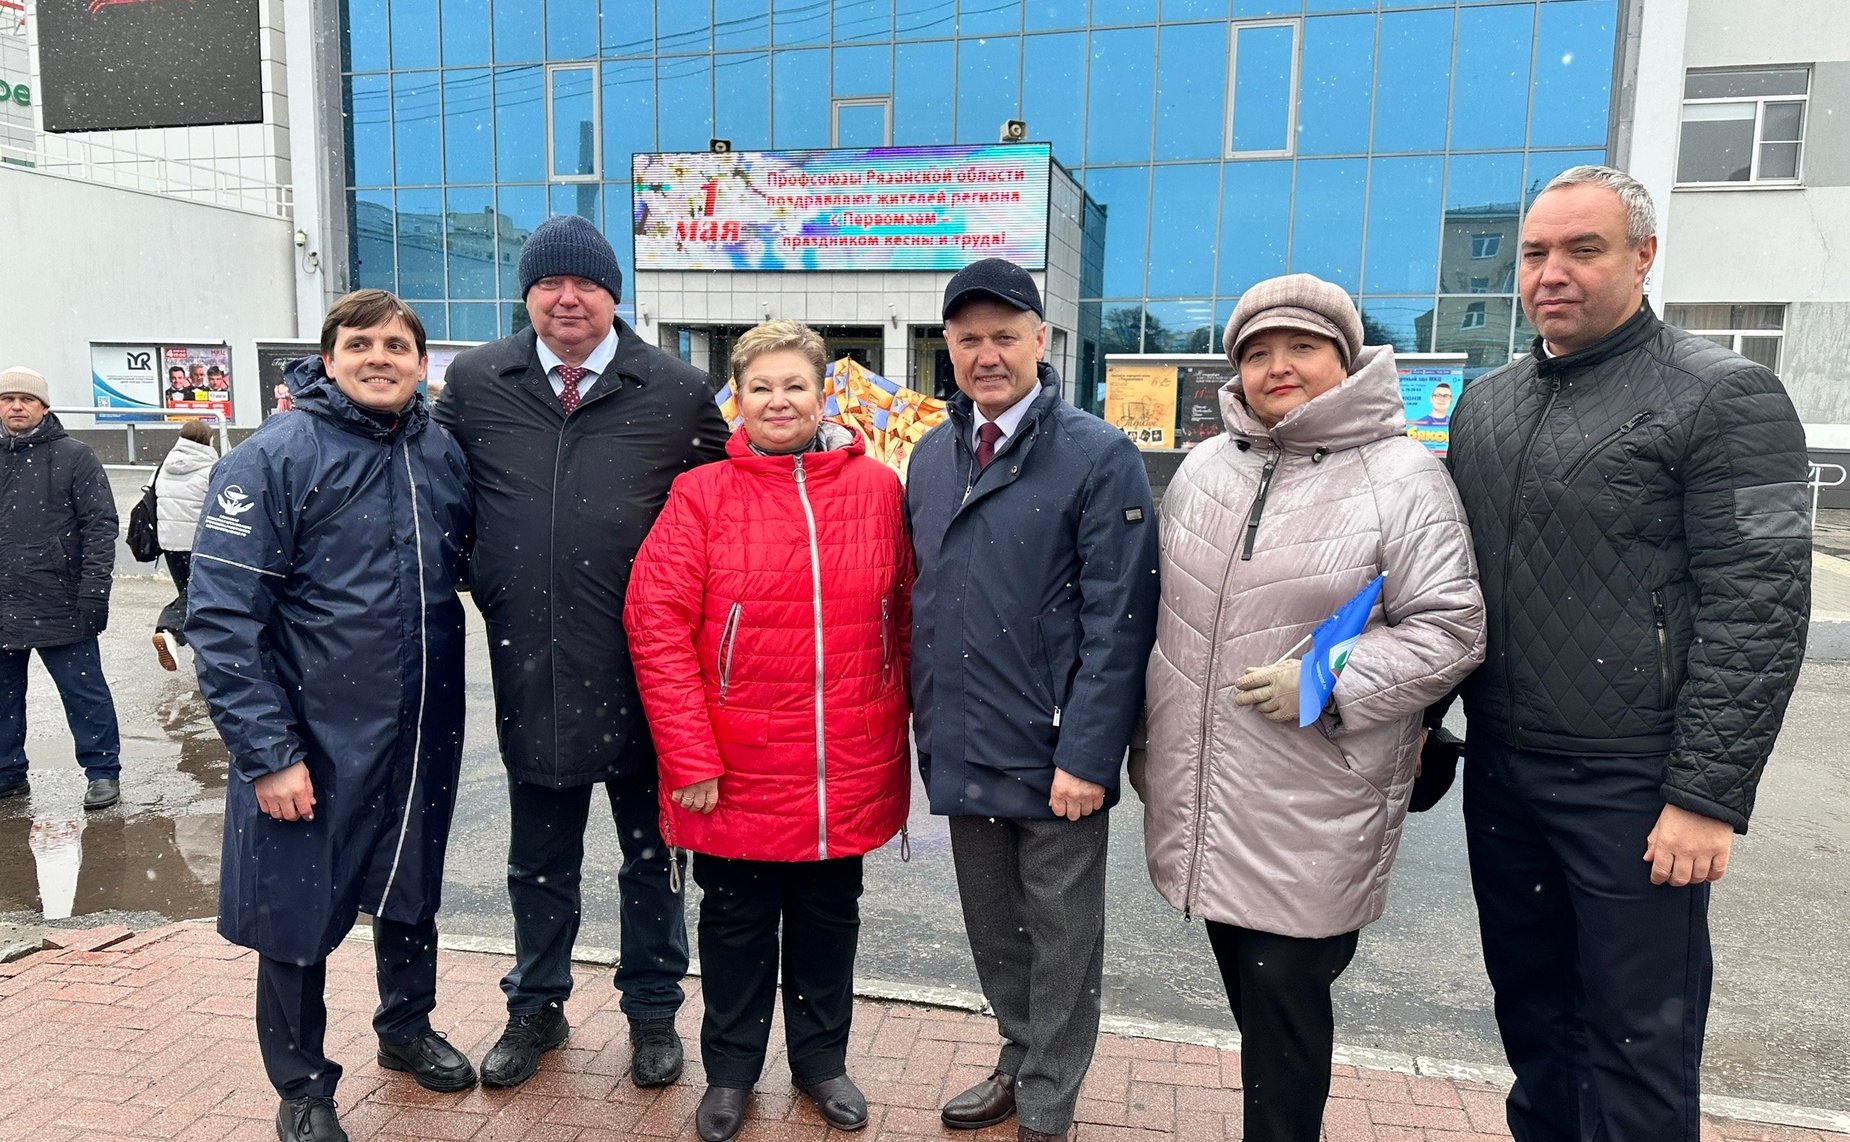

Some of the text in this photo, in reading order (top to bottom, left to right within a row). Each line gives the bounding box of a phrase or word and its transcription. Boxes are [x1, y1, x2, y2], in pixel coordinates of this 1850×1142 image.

[767, 166, 1025, 188] Профсоюзы Рязанской области
[700, 178, 719, 217] 1
[767, 190, 1020, 210] поздравляют жителей региона
[830, 214, 839, 227] с
[843, 211, 936, 228] Первомаем
[677, 221, 741, 242] мая
[782, 231, 1006, 251] праздником весны и труда!
